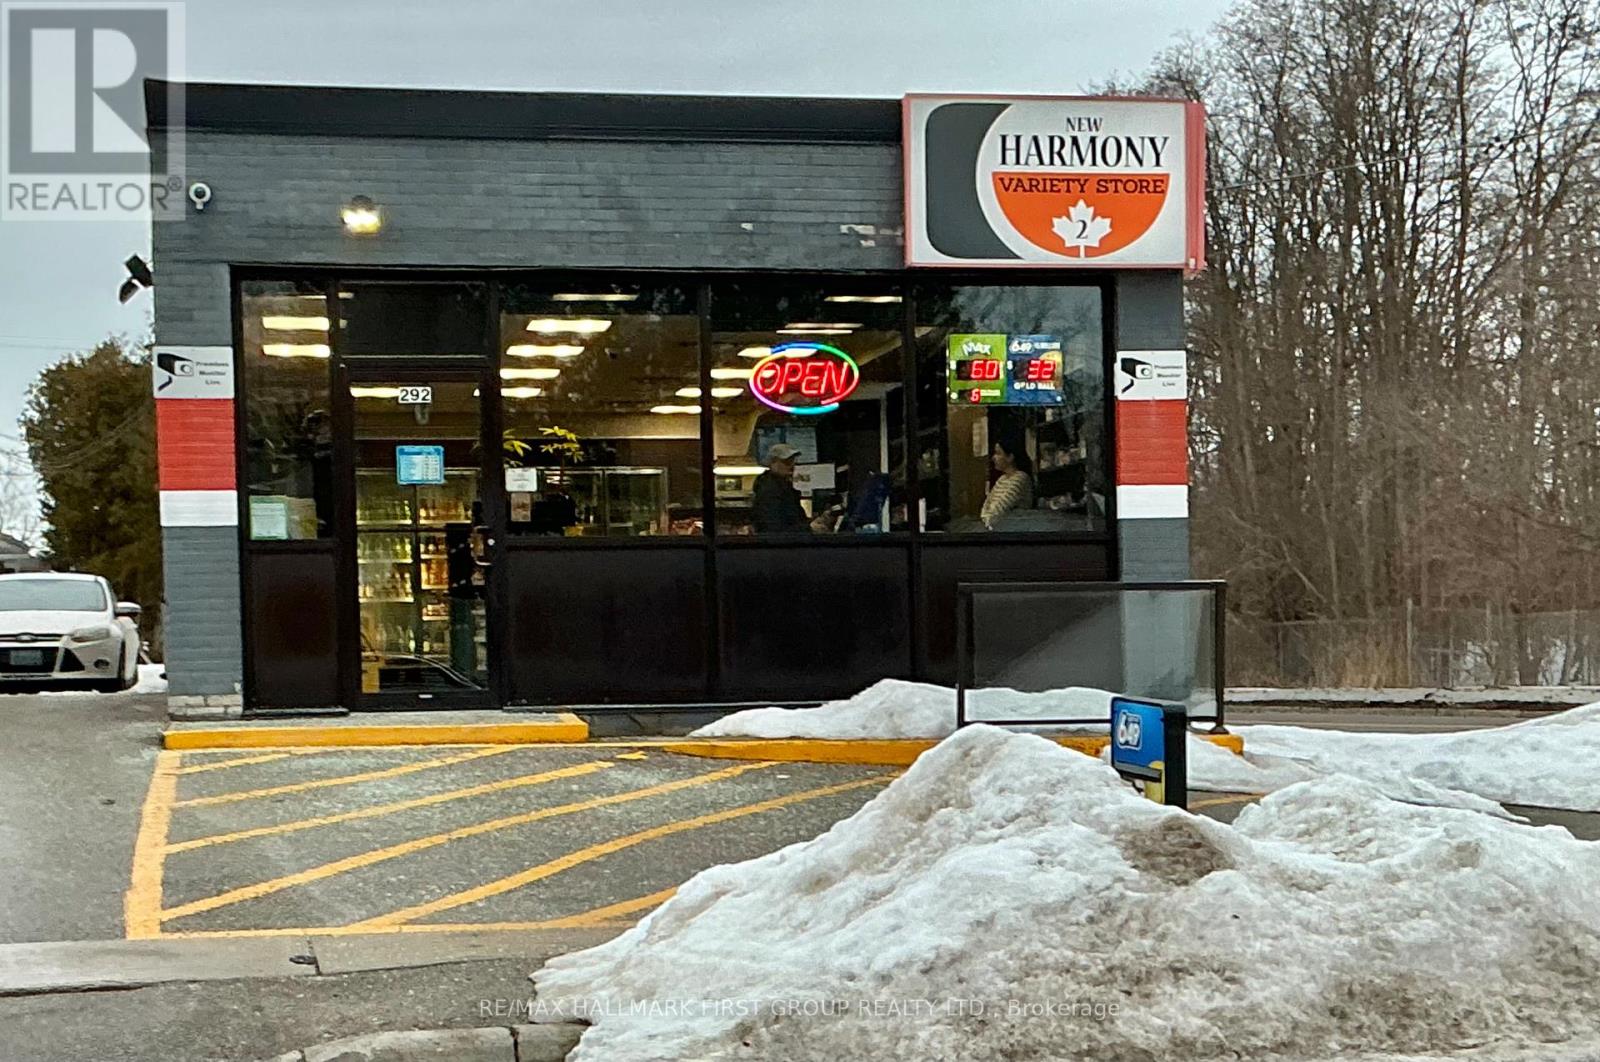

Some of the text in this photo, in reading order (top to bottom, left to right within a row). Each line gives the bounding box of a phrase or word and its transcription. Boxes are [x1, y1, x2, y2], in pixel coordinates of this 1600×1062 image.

[1065, 117, 1103, 132] NEW
[999, 134, 1170, 168] HARMONY
[998, 177, 1166, 194] VARIETY STORE
[1076, 219, 1088, 240] 2
[757, 360, 849, 395] OPEN
[970, 360, 998, 379] 60
[1027, 360, 1054, 379] 32
[400, 388, 431, 402] 292
